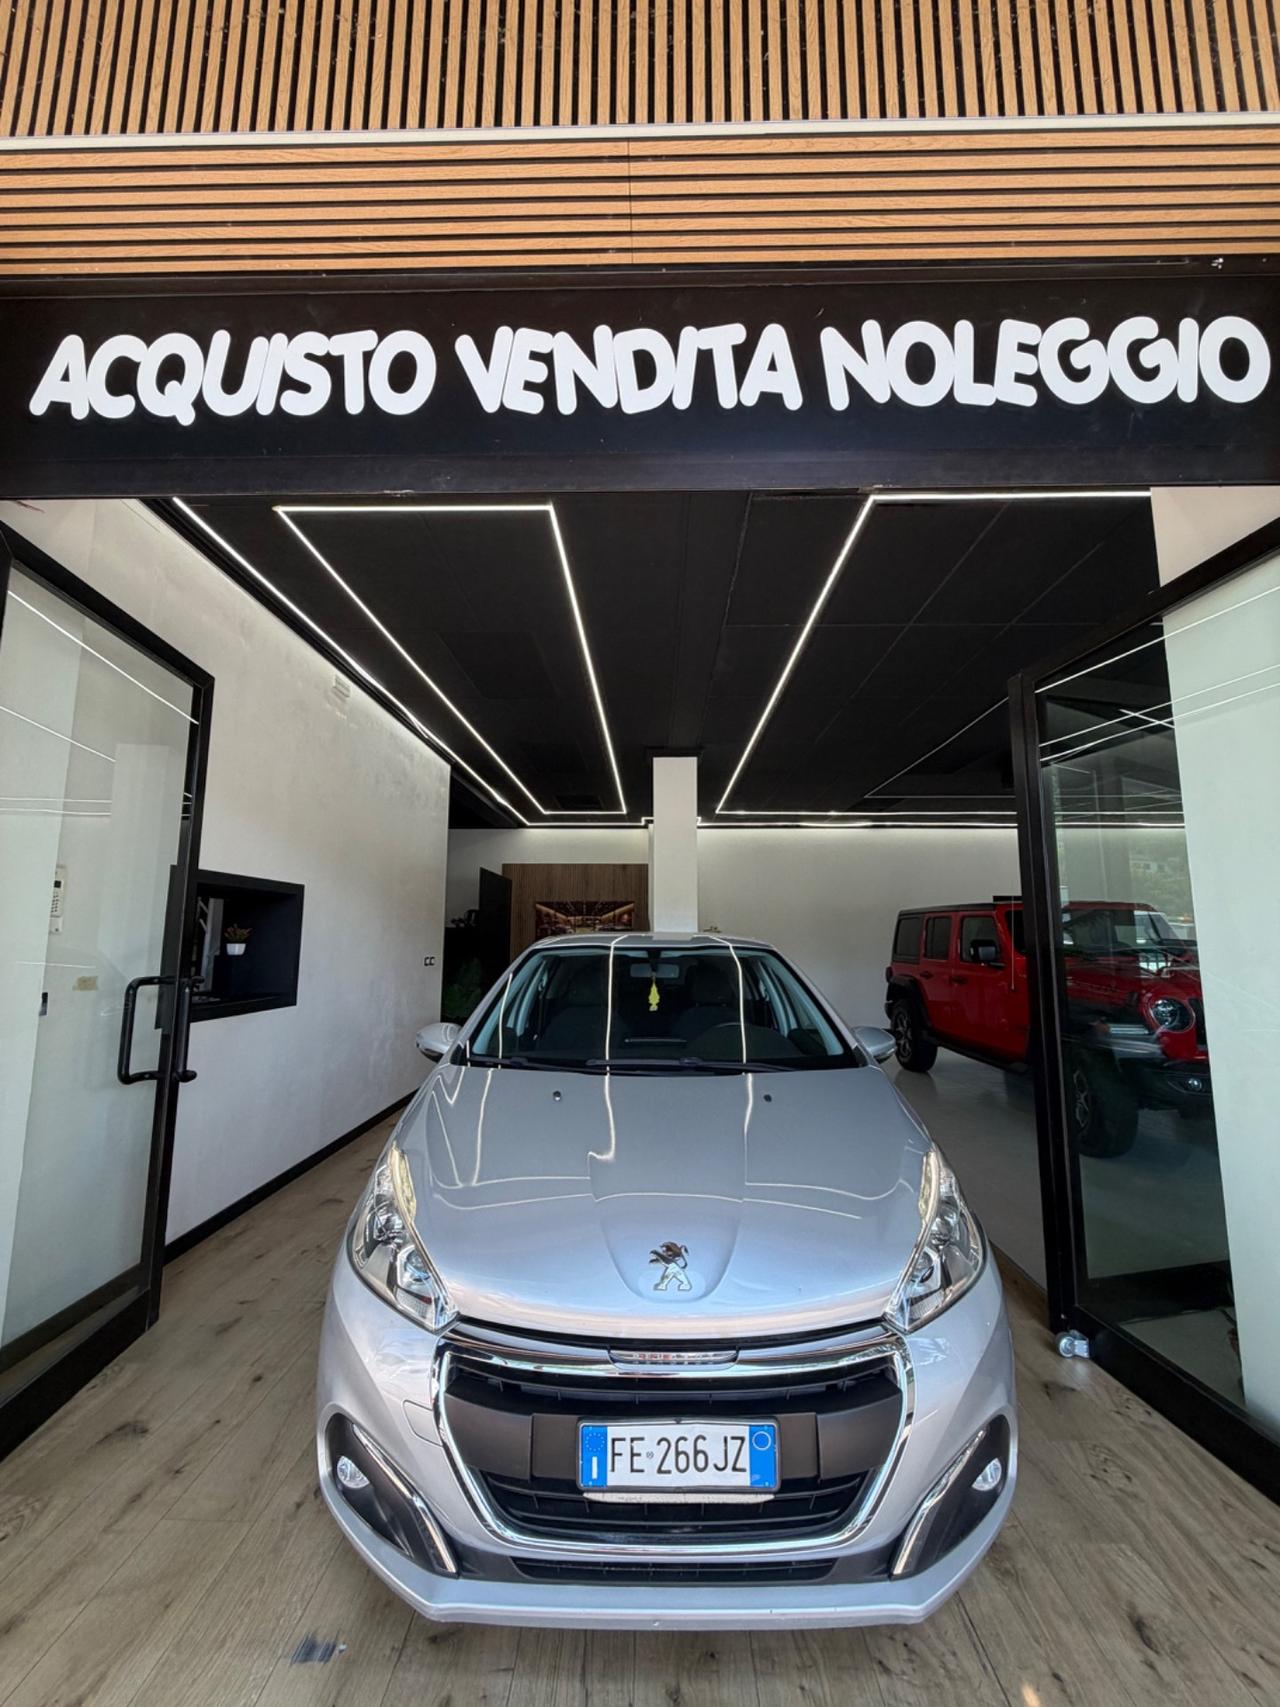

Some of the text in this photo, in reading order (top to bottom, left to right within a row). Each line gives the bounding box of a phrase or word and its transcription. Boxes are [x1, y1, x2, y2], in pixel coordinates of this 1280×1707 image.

[29, 316, 1270, 426] ACQUISTO VENDITA NOLEGGIO
